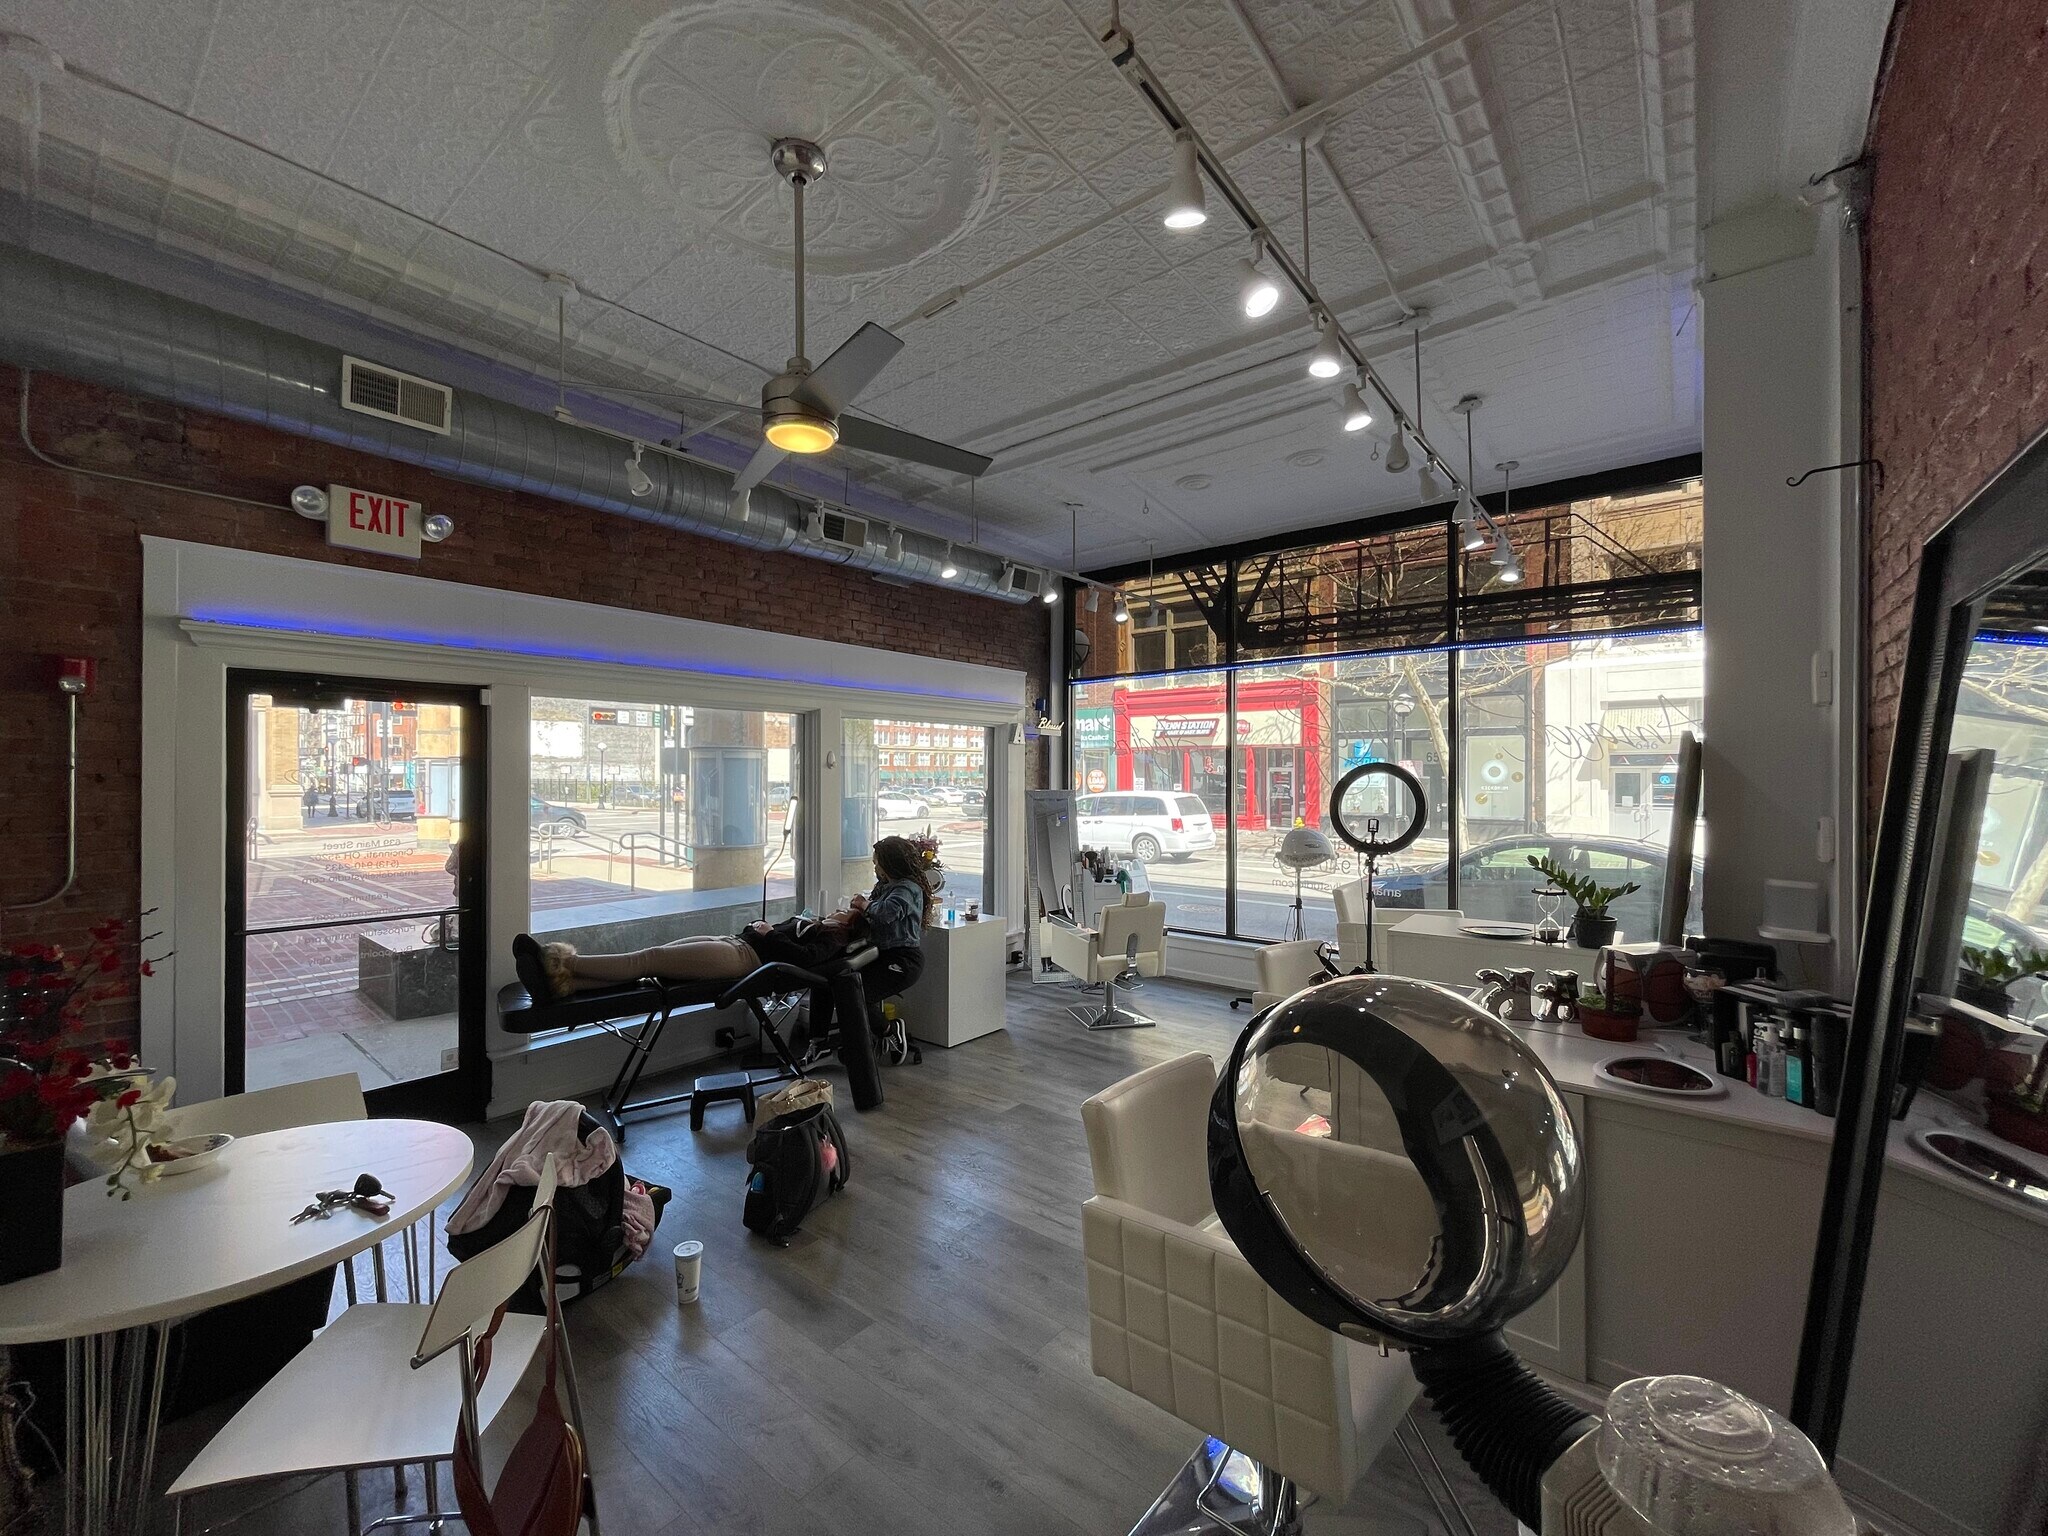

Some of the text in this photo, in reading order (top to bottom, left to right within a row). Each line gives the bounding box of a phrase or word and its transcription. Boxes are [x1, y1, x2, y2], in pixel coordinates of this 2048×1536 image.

[349, 492, 410, 538] EXIT
[1156, 720, 1216, 737] PENN STATION
[1635, 741, 1659, 750] 646
